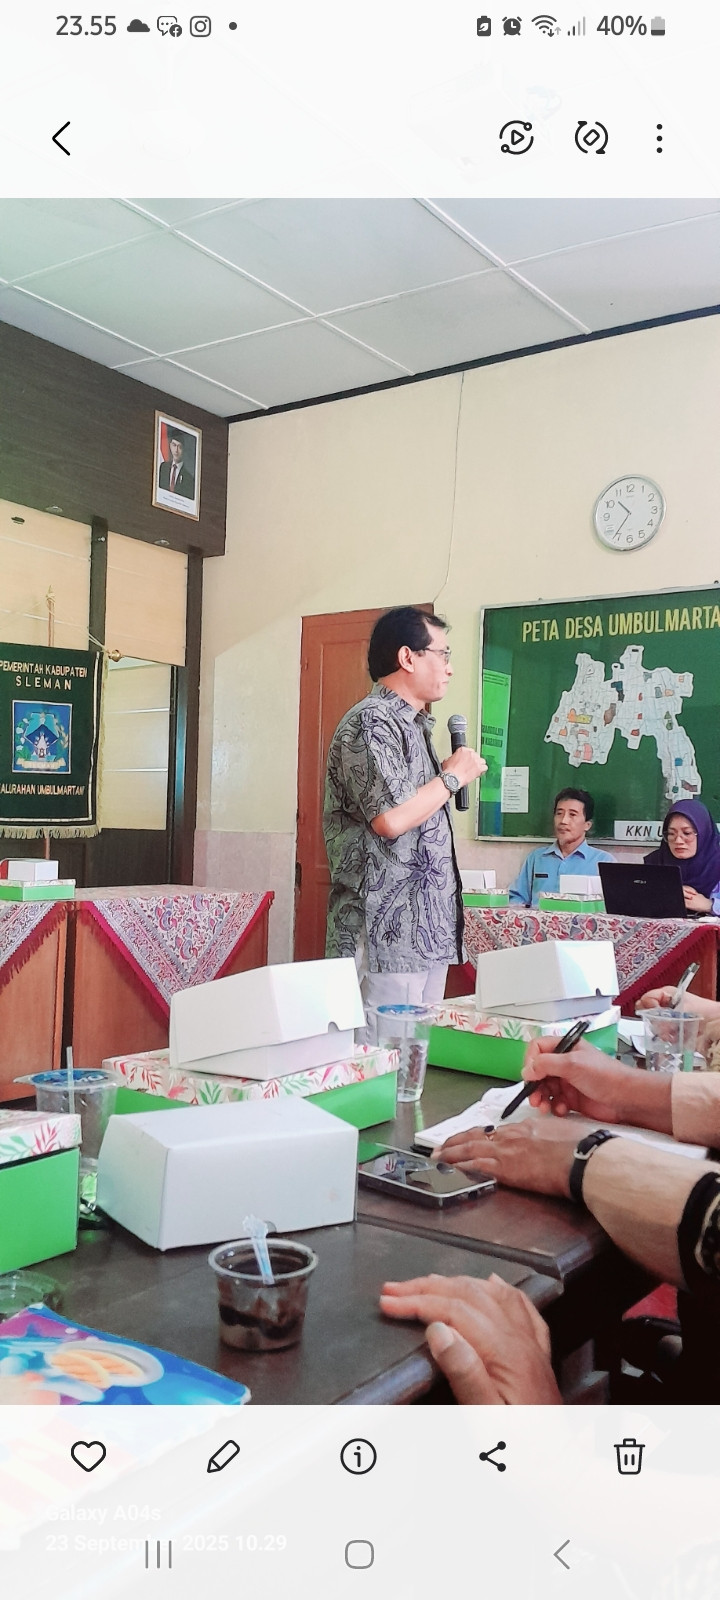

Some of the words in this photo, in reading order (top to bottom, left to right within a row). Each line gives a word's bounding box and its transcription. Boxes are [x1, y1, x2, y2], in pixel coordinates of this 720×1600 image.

[615, 488, 622, 497] 11
[626, 484, 635, 493] 12
[641, 485, 645, 493] 1
[647, 493, 655, 502] 2
[604, 500, 615, 508] 10
[650, 506, 658, 514] 3
[603, 513, 611, 521] 9
[616, 532, 622, 541] 7
[638, 530, 645, 538] 5
[626, 535, 634, 543] 6
[522, 619, 560, 643] PETA
[565, 615, 604, 640] DESA
[608, 605, 720, 636] UMBULMARTA
[45, 664, 88, 678] KABUPATEN
[15, 675, 72, 690] SLEMAN
[0, 783, 36, 795] ALURAHAN
[625, 825, 652, 837] KKN
